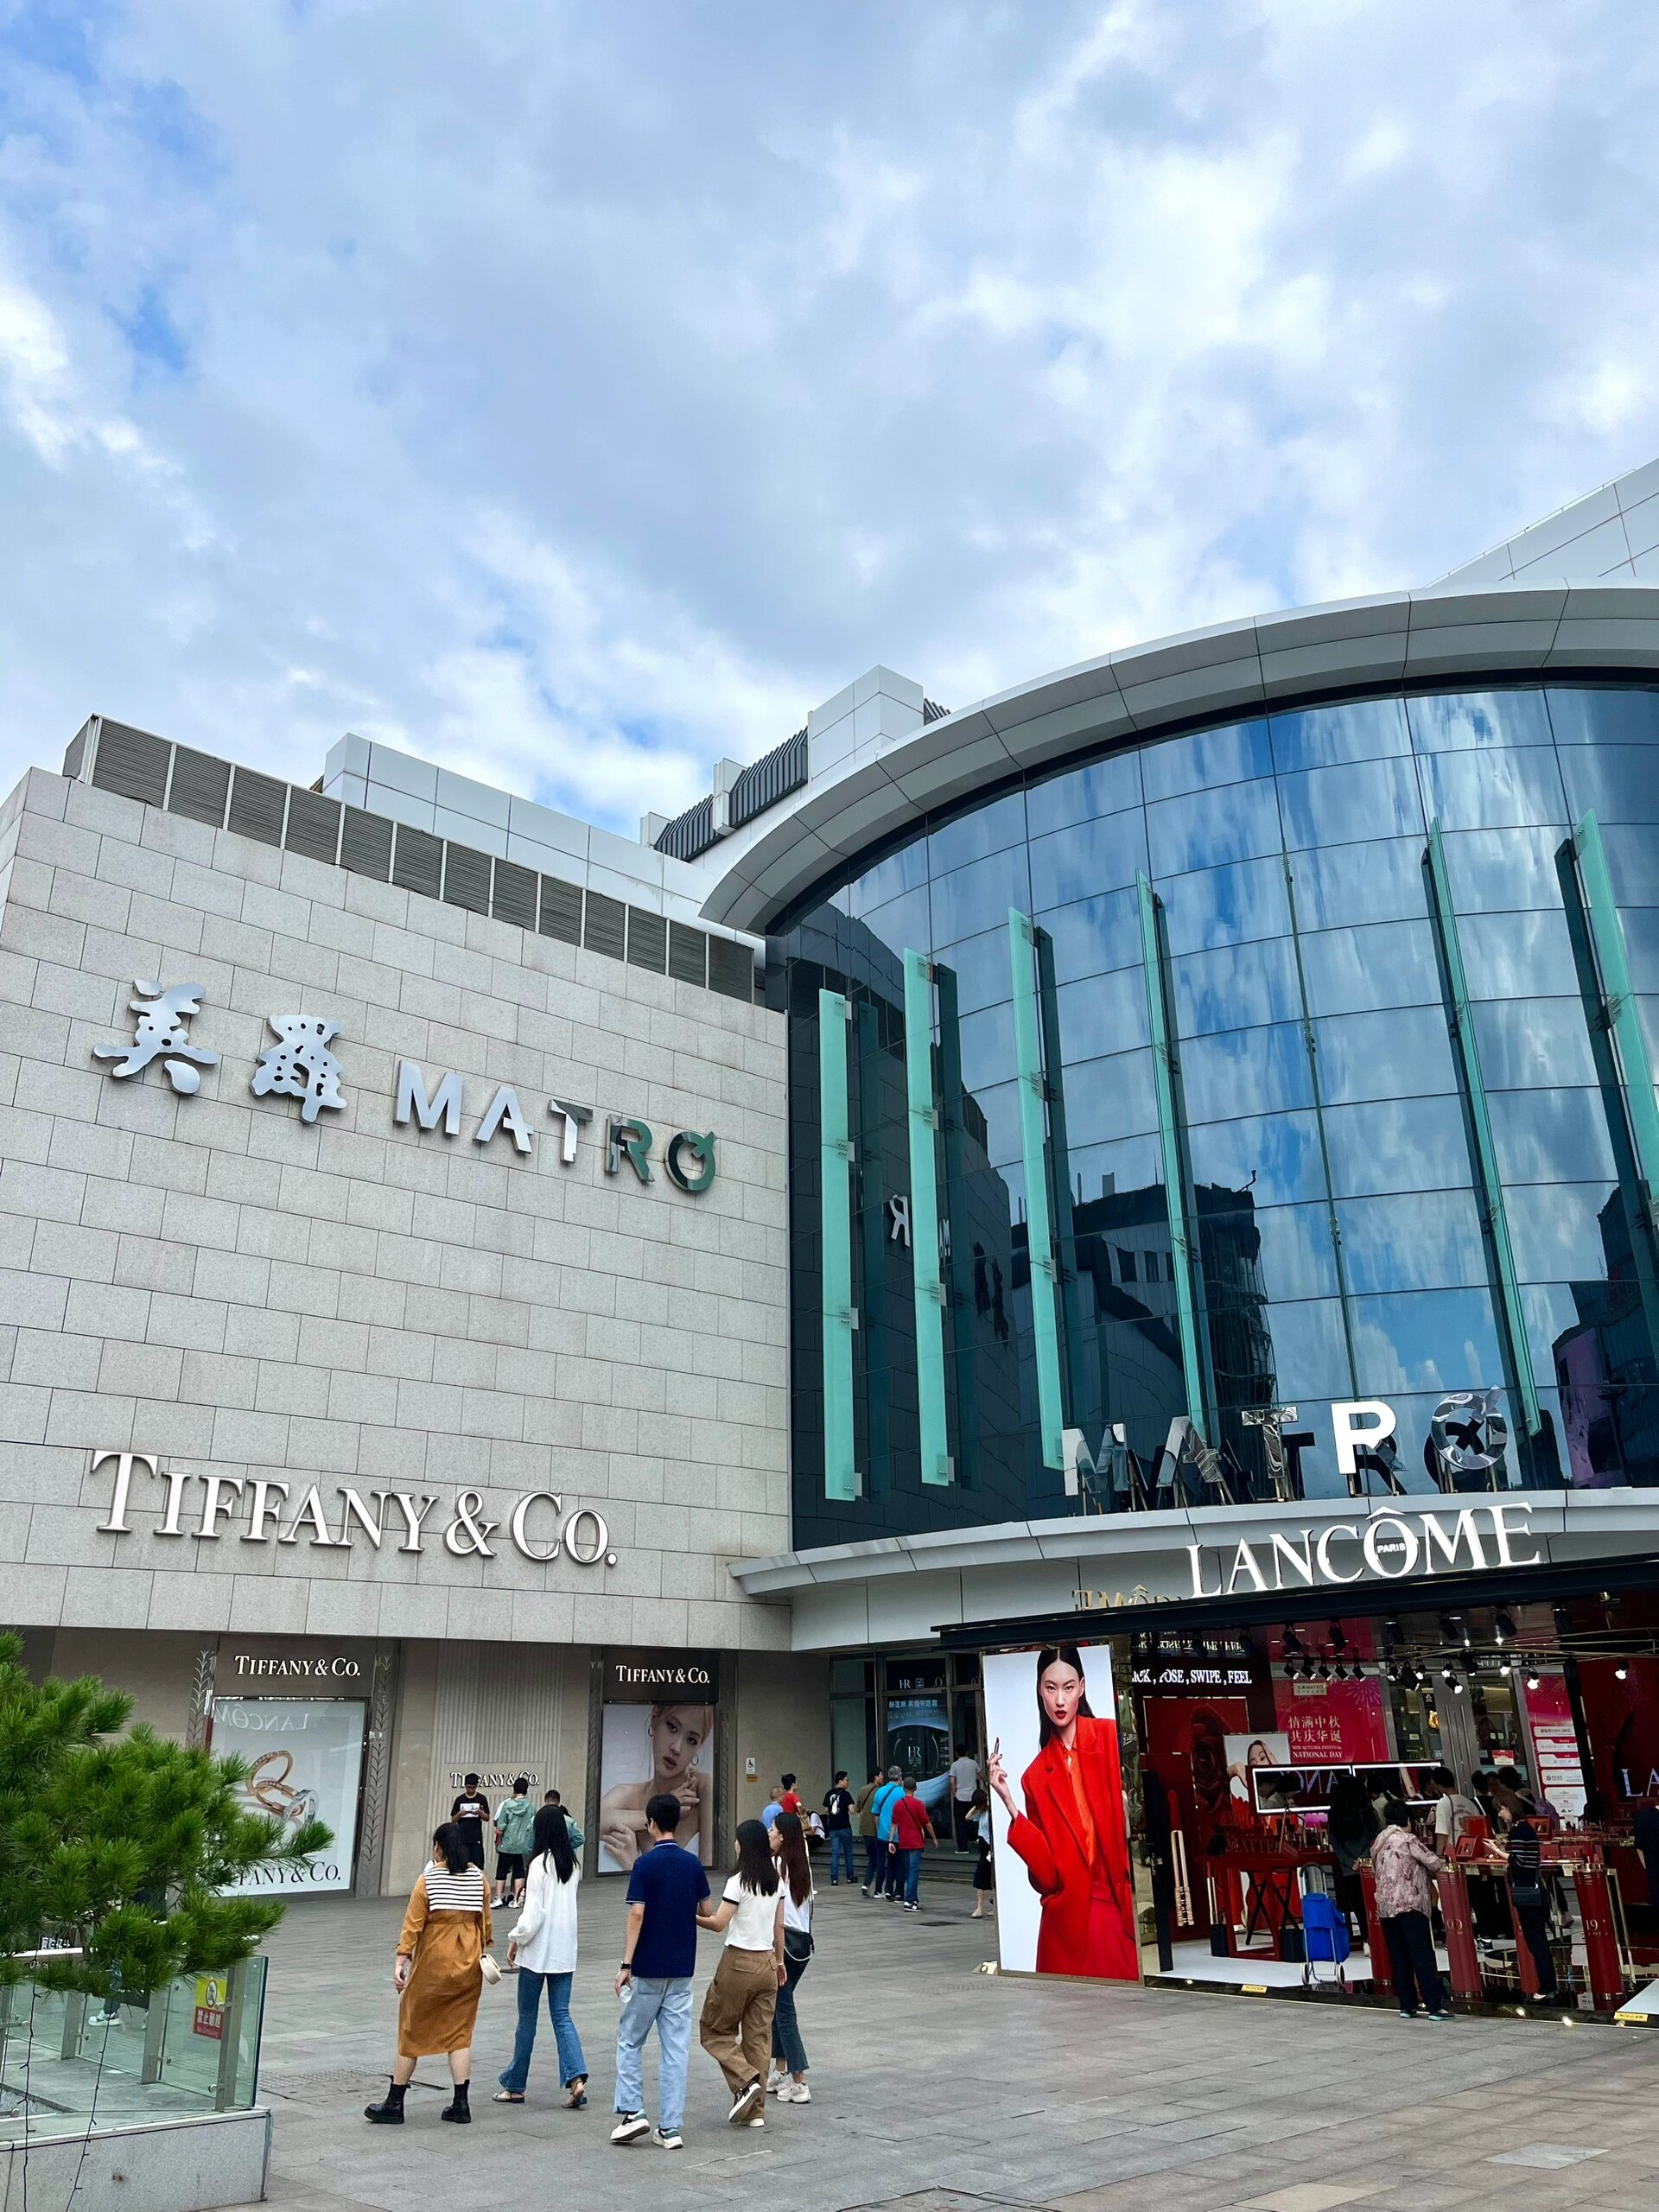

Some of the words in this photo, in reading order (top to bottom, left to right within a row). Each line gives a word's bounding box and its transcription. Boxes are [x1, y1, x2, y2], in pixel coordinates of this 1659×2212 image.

[394, 1059, 717, 1192] MATRO
[1061, 1385, 1507, 1497] MATRO
[1186, 1502, 1541, 1599] LANCÔME
[1376, 1542, 1406, 1554] PARIS
[1227, 1670, 1253, 1684] FEEL
[1288, 1715, 1341, 1729] 情满中秋
[1290, 1729, 1342, 1743] 共庆华诞
